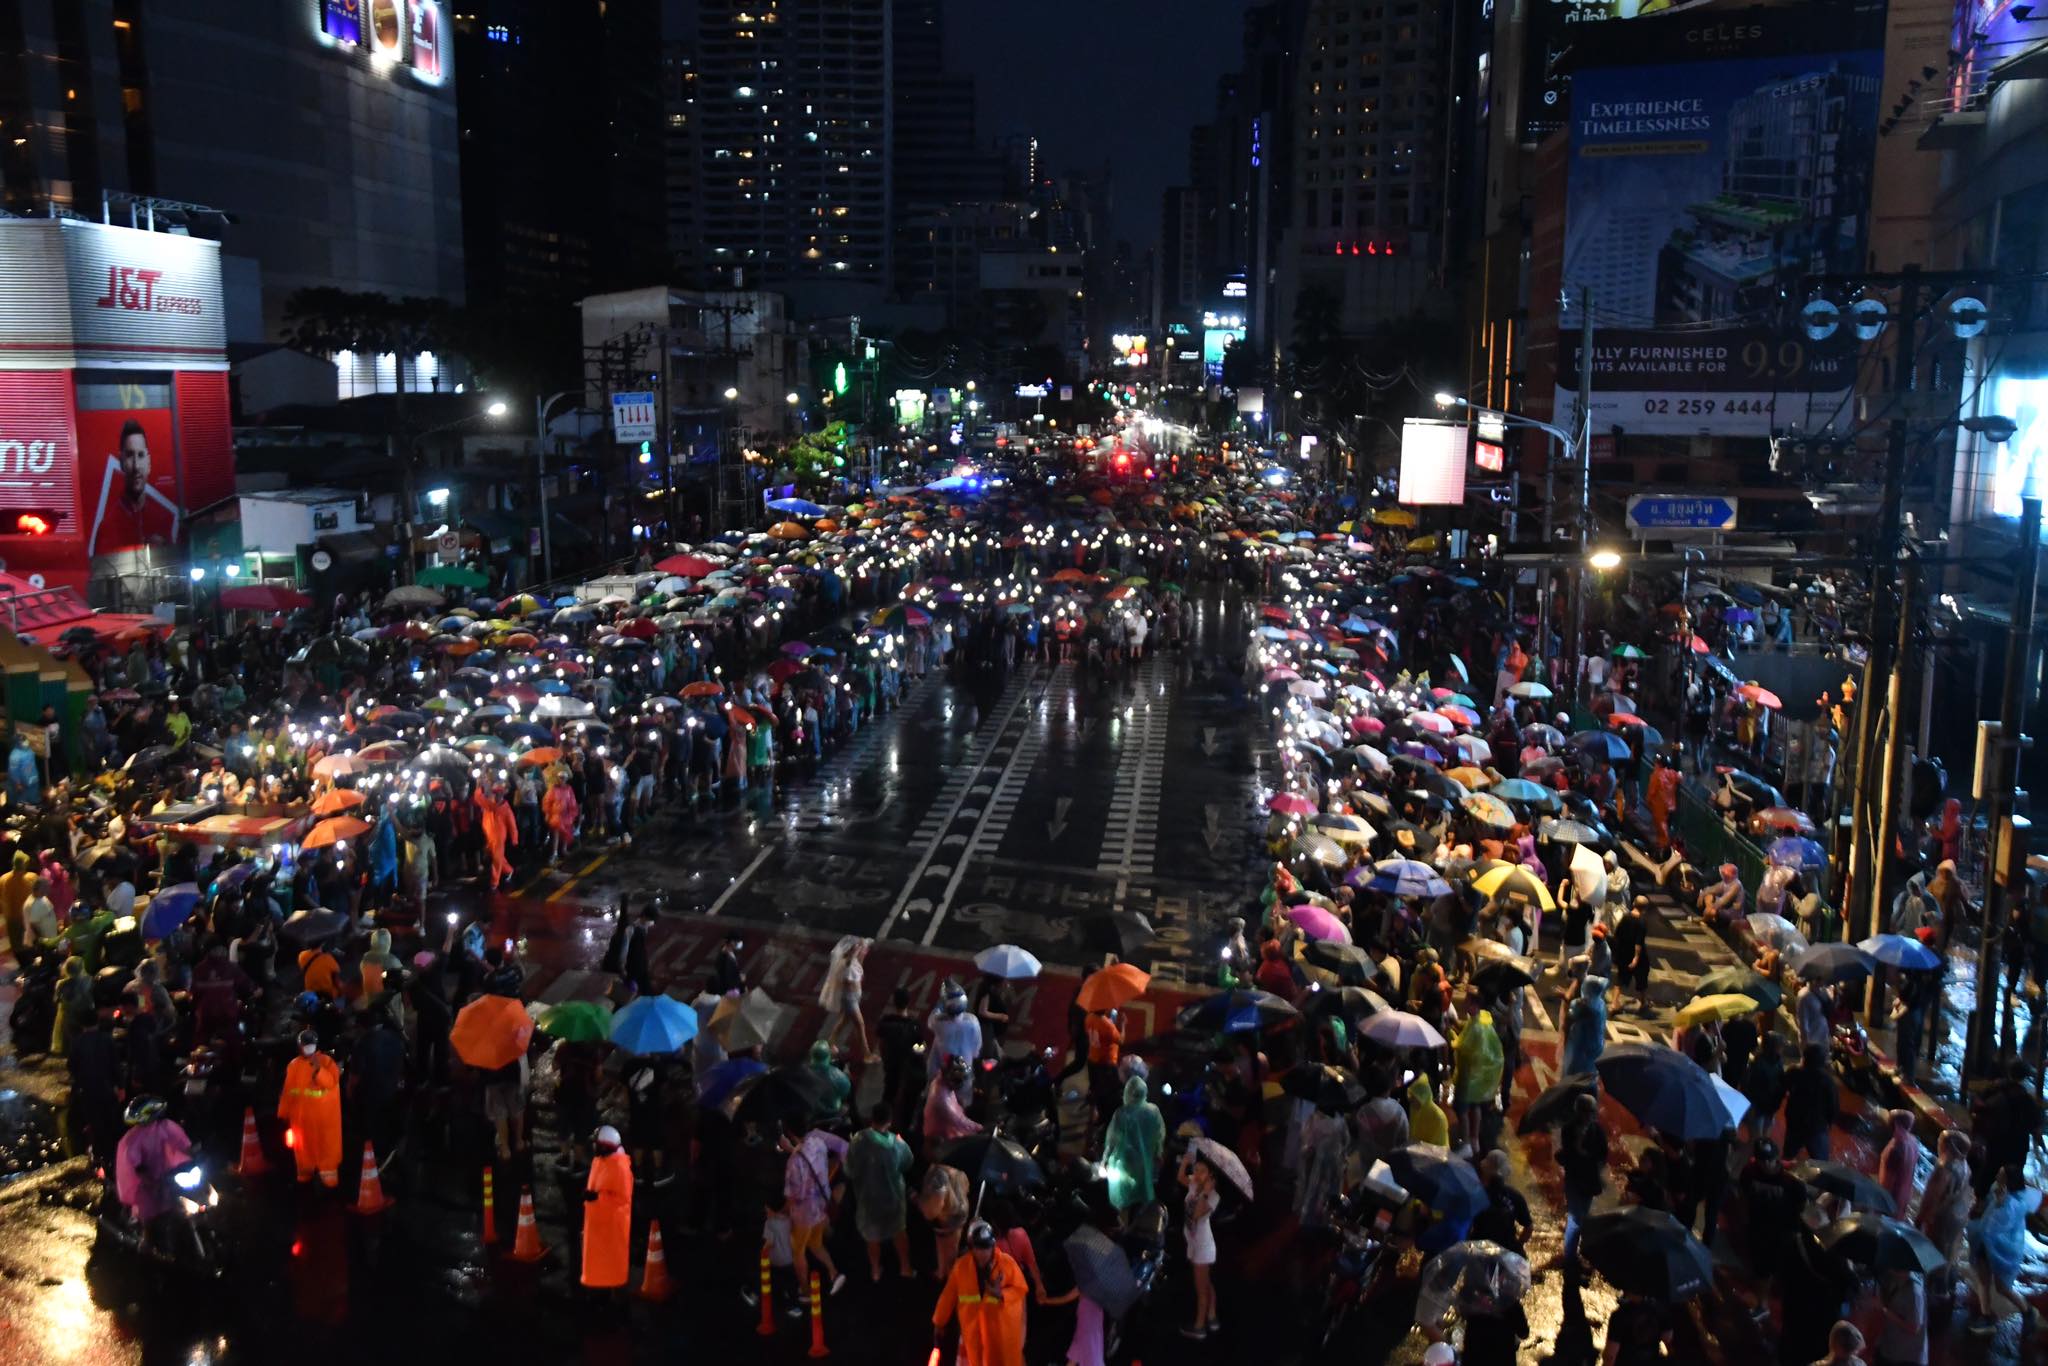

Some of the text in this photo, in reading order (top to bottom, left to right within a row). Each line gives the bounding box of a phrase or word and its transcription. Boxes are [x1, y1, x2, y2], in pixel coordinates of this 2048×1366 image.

[1684, 25, 1764, 42] CELES
[1590, 97, 1703, 118] EXPERIENCE
[1580, 116, 1712, 136] TIMELESSNESS
[97, 266, 162, 312] J&T
[1575, 345, 1729, 360] FLLY FURNISHED
[1742, 338, 1804, 380] 9.9
[1618, 360, 1692, 373] AVAILABLE
[1697, 360, 1727, 373] FOR
[1645, 399, 1776, 415] 02 259 4444
